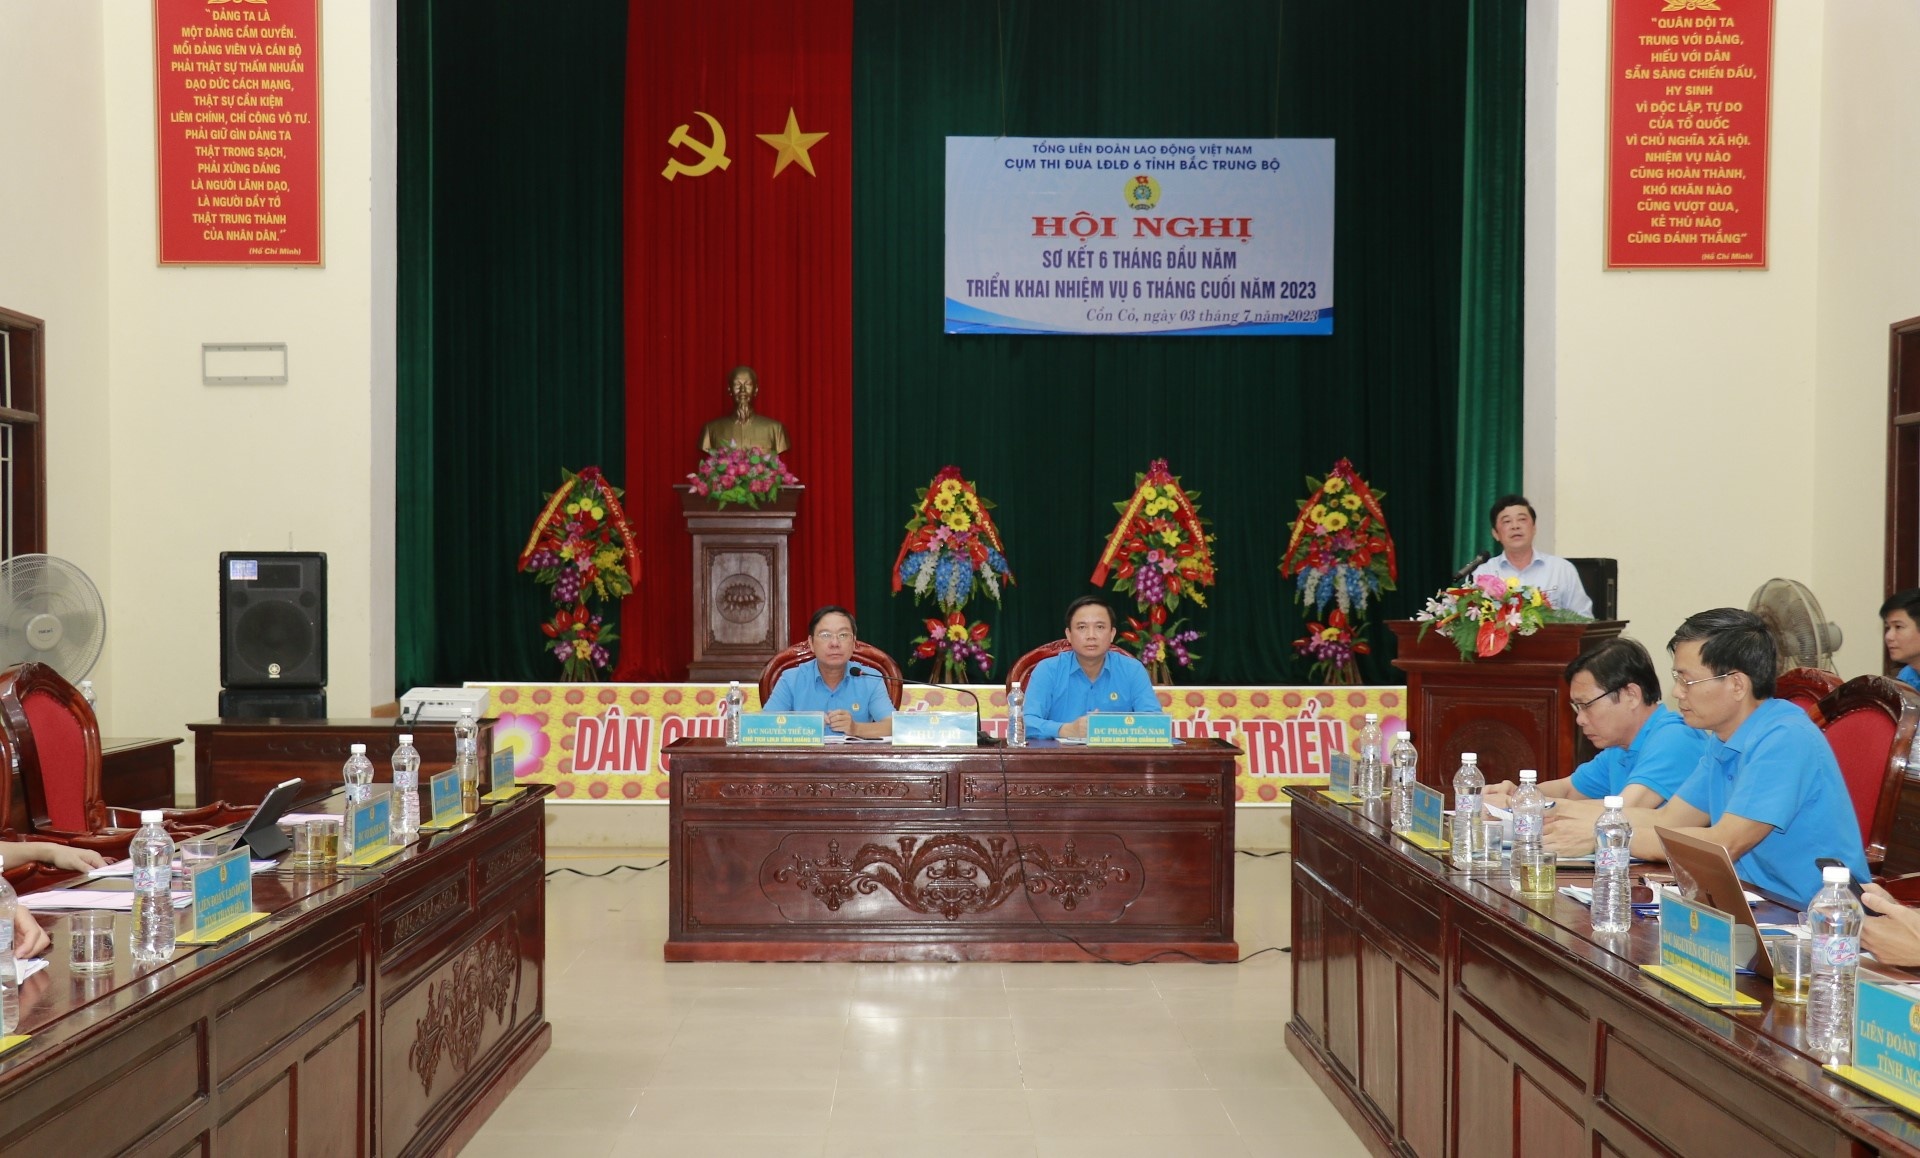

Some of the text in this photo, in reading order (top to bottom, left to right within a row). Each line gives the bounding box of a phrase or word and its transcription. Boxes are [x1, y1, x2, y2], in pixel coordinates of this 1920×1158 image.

[182, 26, 204, 40] MỘT
[204, 25, 234, 38] ĐẢNG
[260, 25, 296, 38] QUYỀN.
[1638, 31, 1744, 46] TRUNG VỚI ĐẢNG,
[172, 40, 302, 58] MỖI ĐẢNG VIÊN VÀ CÁN BỘ
[1650, 48, 1730, 62] HIẾU VỚI DÂN
[172, 58, 194, 72] PHẢI
[196, 60, 222, 74] THẬT
[224, 60, 238, 74] SỰ
[238, 58, 268, 72] THẤM
[1652, 66, 1686, 80] SÀNG
[1688, 64, 1724, 78] CHIẾN
[1726, 64, 1756, 78] ĐẤU,
[186, 76, 294, 92] ĐẠO ĐỨC CÁCH MẠNG,
[1666, 86, 1712, 96] HY SINH
[1636, 100, 1742, 116] VÌ ĐỘC LẬP, TỰ DO
[170, 110, 310, 124] LIÊM CHÍNH, CHÍ CÔNG VÔ TƯ.
[1648, 113, 1730, 130] CỦA TỔ QUỐC
[186, 126, 292, 140] PHẢI GIỮ GÌN ĐẢNG TA
[1626, 134, 1638, 146] VÌ
[1640, 132, 1666, 146] CHỦ
[1668, 132, 1706, 146] NGHĨA
[1708, 134, 1726, 146] XÃ
[194, 144, 286, 160] THẬT TRONG SẠCH,
[1032, 142, 1252, 156] TỔNG LIÊN ĐOÀN LAO ĐỘNG VIỆT NAM
[1646, 150, 1732, 164] NHIỆM VỤ NÀO
[1004, 156, 1280, 174] CỤM THI ĐUA LĐLĐ 6 TỈNH BẮC TRUNG BỘ
[1630, 166, 1746, 180] CŨNG HOÀN THÀNH,
[192, 178, 290, 194] LÀ NGƯỜI LÃNH ĐẠO,
[1642, 182, 1732, 196] KHÓ KHĂN NÀO
[1636, 198, 1738, 214] CŨNG VƯỢT QUA,
[192, 212, 286, 226] THẬT TRUNG THÀNH
[1650, 214, 1722, 228] KẺ THÙ NÀO
[204, 226, 224, 240] CỦA
[226, 228, 254, 240] NHÂN
[1030, 211, 1254, 244] HỘI NGHỊ
[1042, 244, 1236, 270] SƠ KẾT 6 THÁNG ĐẦU NĂM
[966, 272, 1316, 302] TRIỂN KHAI NHIỆM VỤ 6 THÁNG CUỐI NĂM 2023
[1086, 307, 1320, 325] Cồn Cỏ, ngày 03 tháng 7 năm 2023
[574, 706, 651, 771] DÂN
[1243, 699, 1345, 774] TRIỂN
[1860, 1019, 1917, 1059] LIÊN ĐOÀN
[1877, 1050, 1903, 1079] TỈNH
